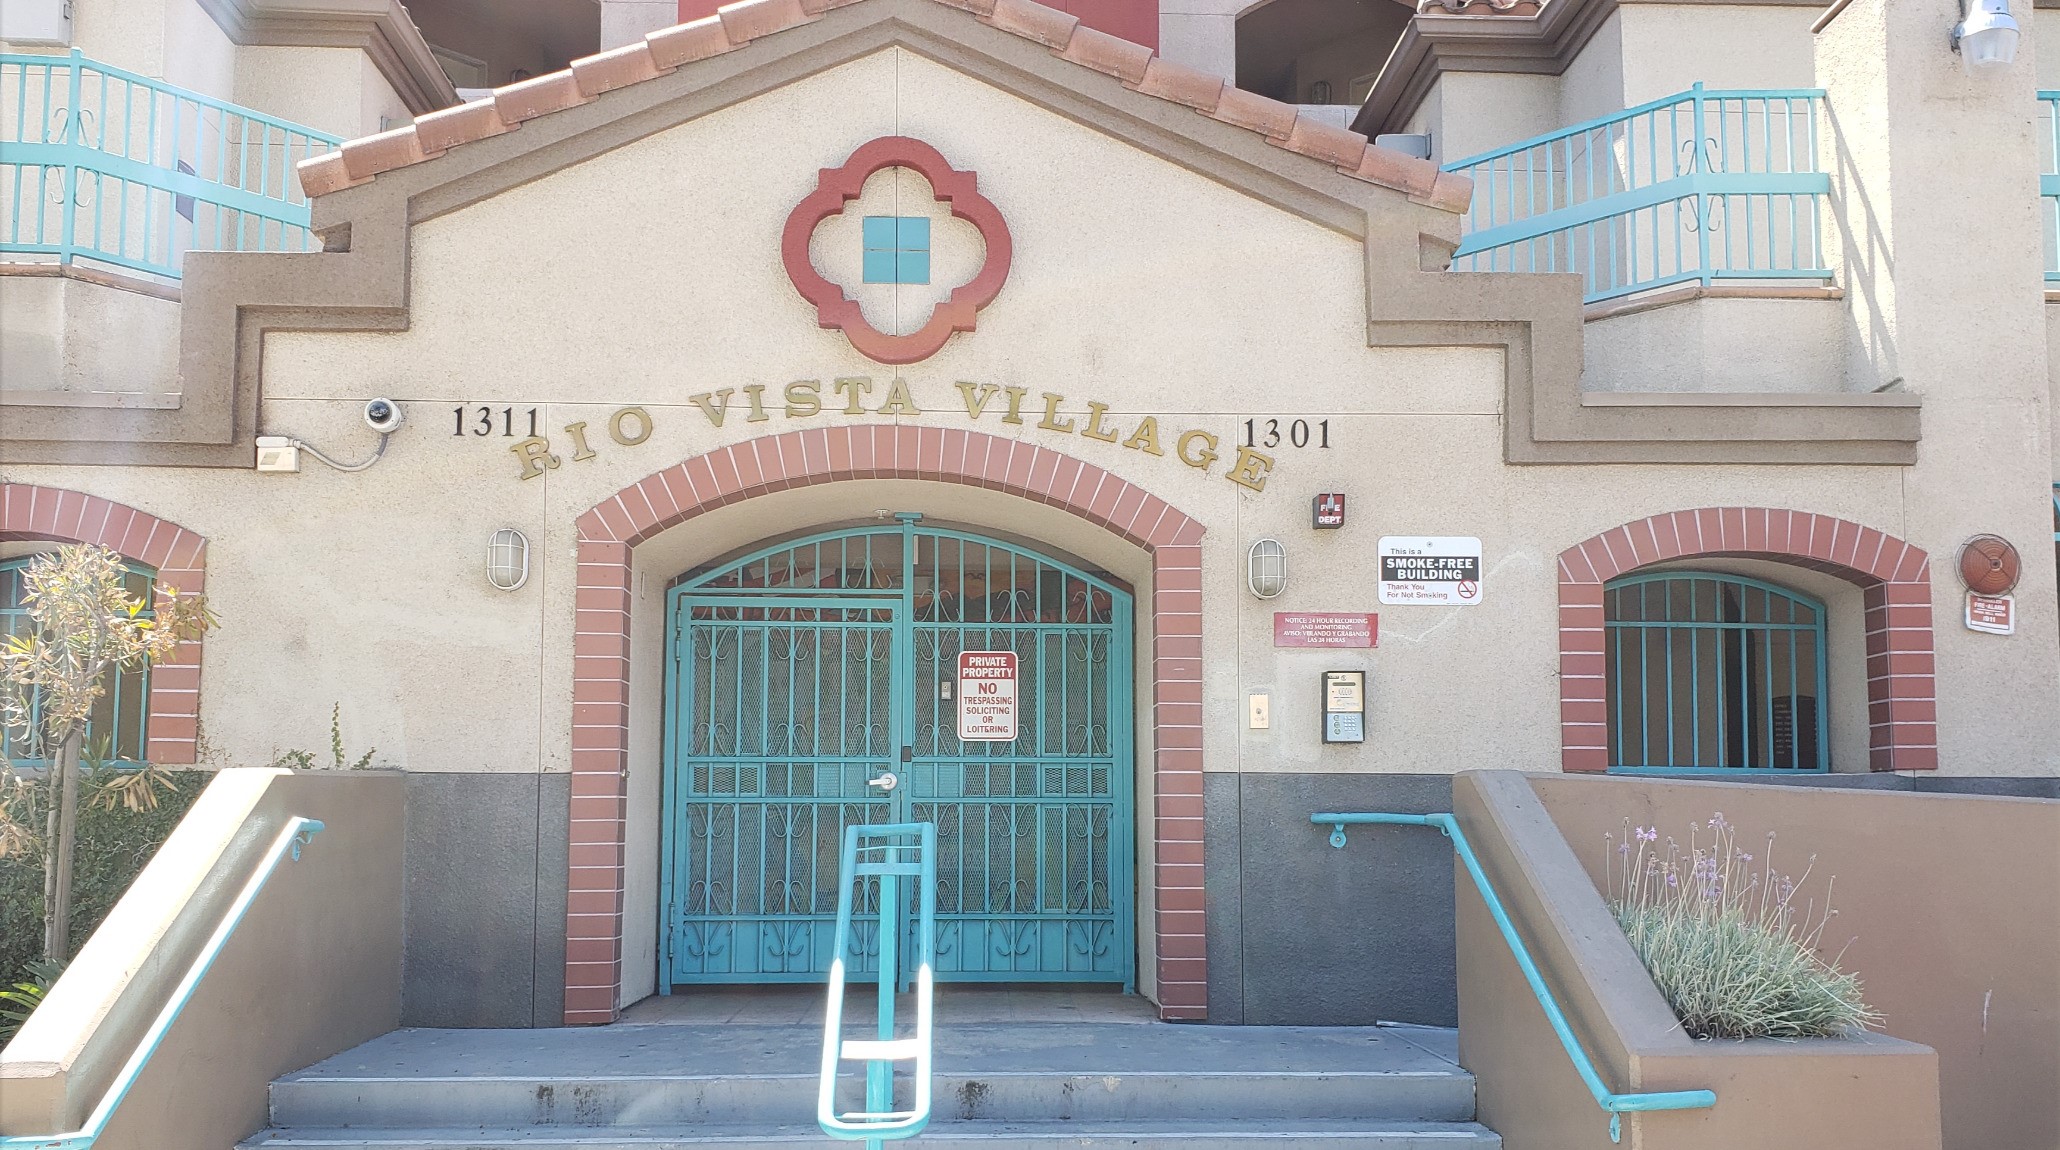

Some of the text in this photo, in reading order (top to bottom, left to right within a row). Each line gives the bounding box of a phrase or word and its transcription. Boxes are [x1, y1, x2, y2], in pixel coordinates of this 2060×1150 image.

[453, 405, 540, 437] 1311
[510, 377, 1275, 492] RIO VISTA VILLAGE
[1244, 417, 1331, 449] 1301
[1320, 504, 1341, 512] FIE
[1386, 558, 1473, 569] SMOKE-FREE
[1397, 569, 1463, 580] BUILDING
[1416, 592, 1448, 600] Smking
[969, 656, 1007, 667] PRIVATE
[962, 667, 1013, 677] PROPERTY
[978, 683, 997, 694] NO
[964, 696, 1012, 705] TRESPASSING
[966, 707, 1010, 715] SOLICITING
[982, 715, 993, 723] OR
[967, 725, 1009, 733] LOITERING
